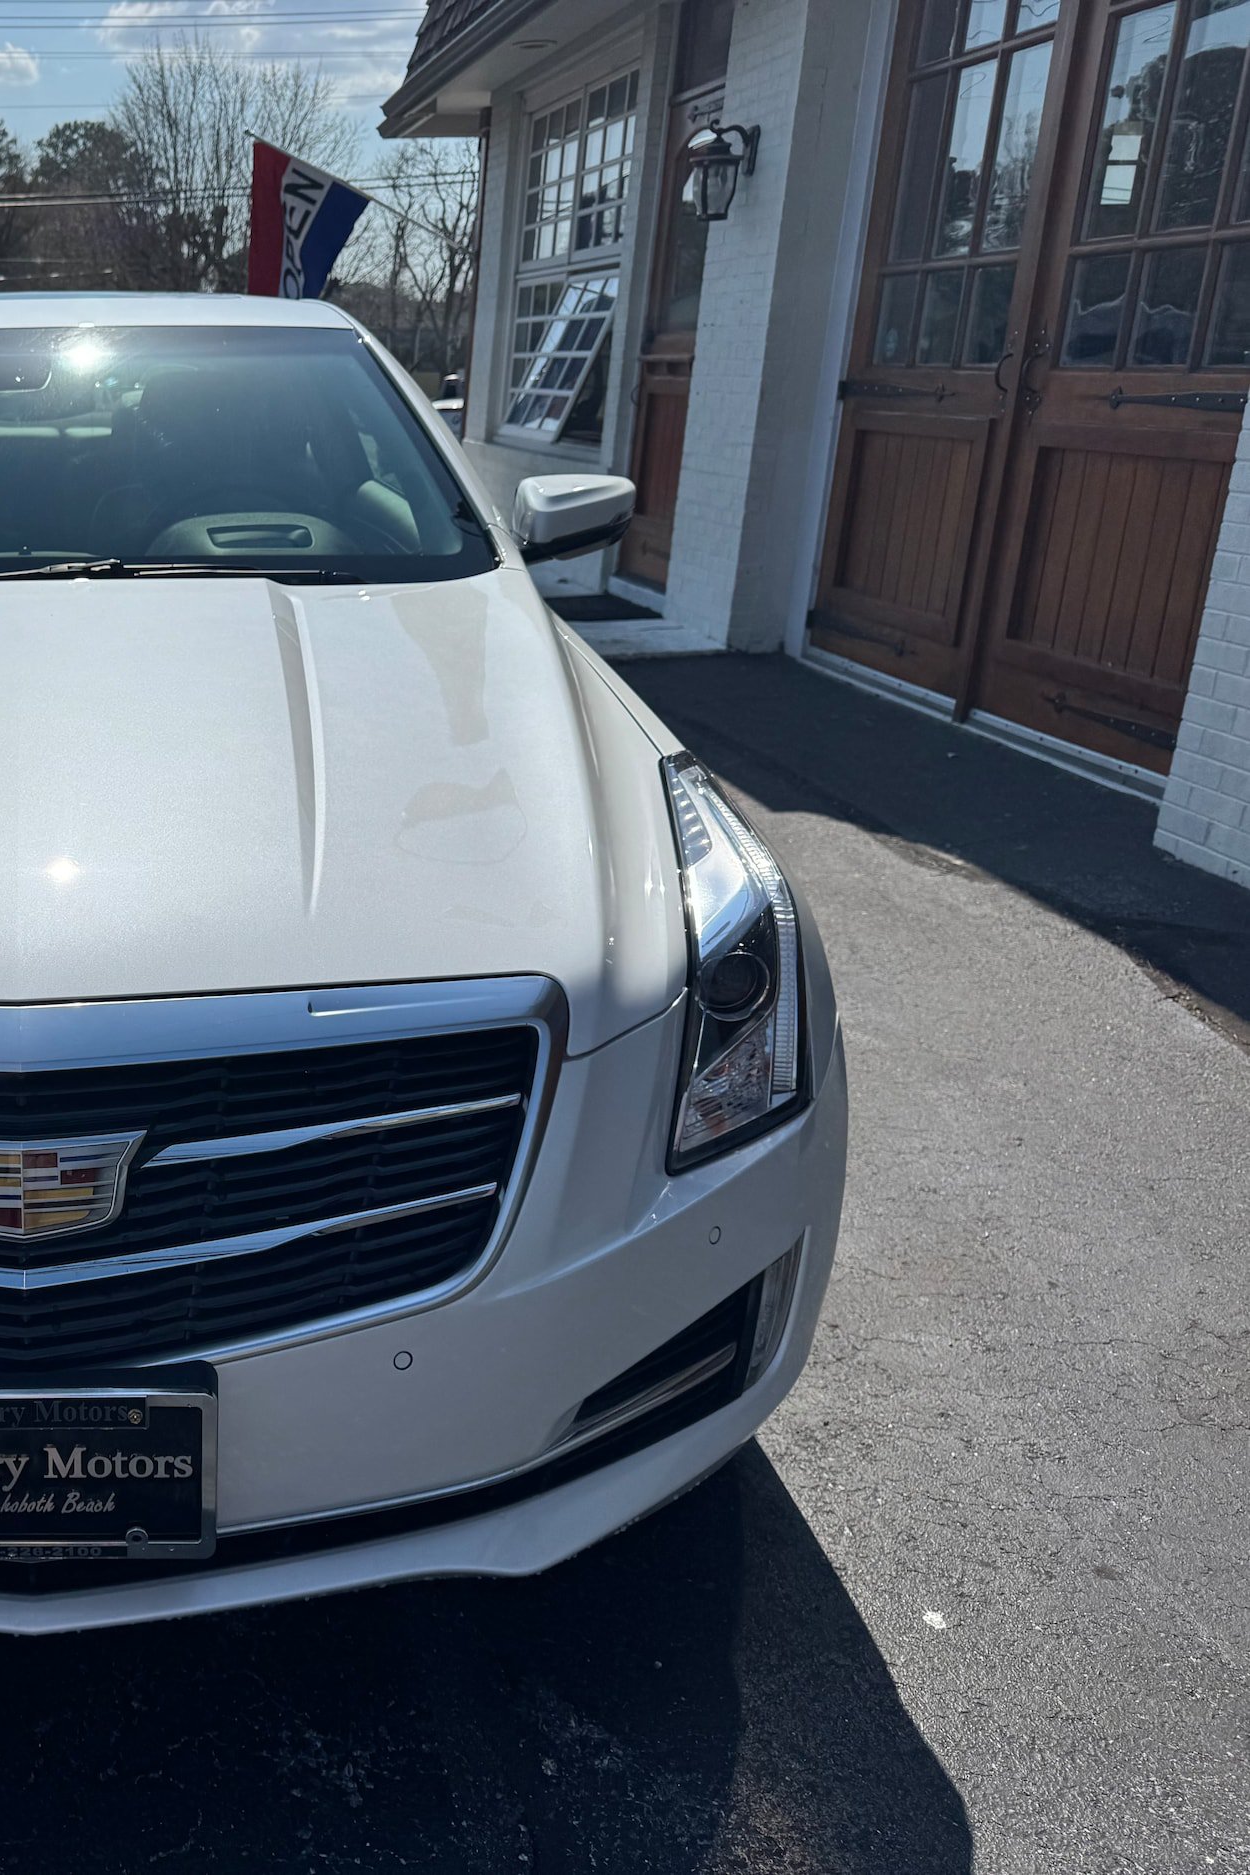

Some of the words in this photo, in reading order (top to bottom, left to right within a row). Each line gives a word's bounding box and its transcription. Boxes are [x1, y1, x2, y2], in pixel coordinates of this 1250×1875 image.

[282, 167, 326, 300] OPEN
[34, 1400, 128, 1423] Motors
[43, 1445, 193, 1479] Motors
[60, 1490, 116, 1514] Beach
